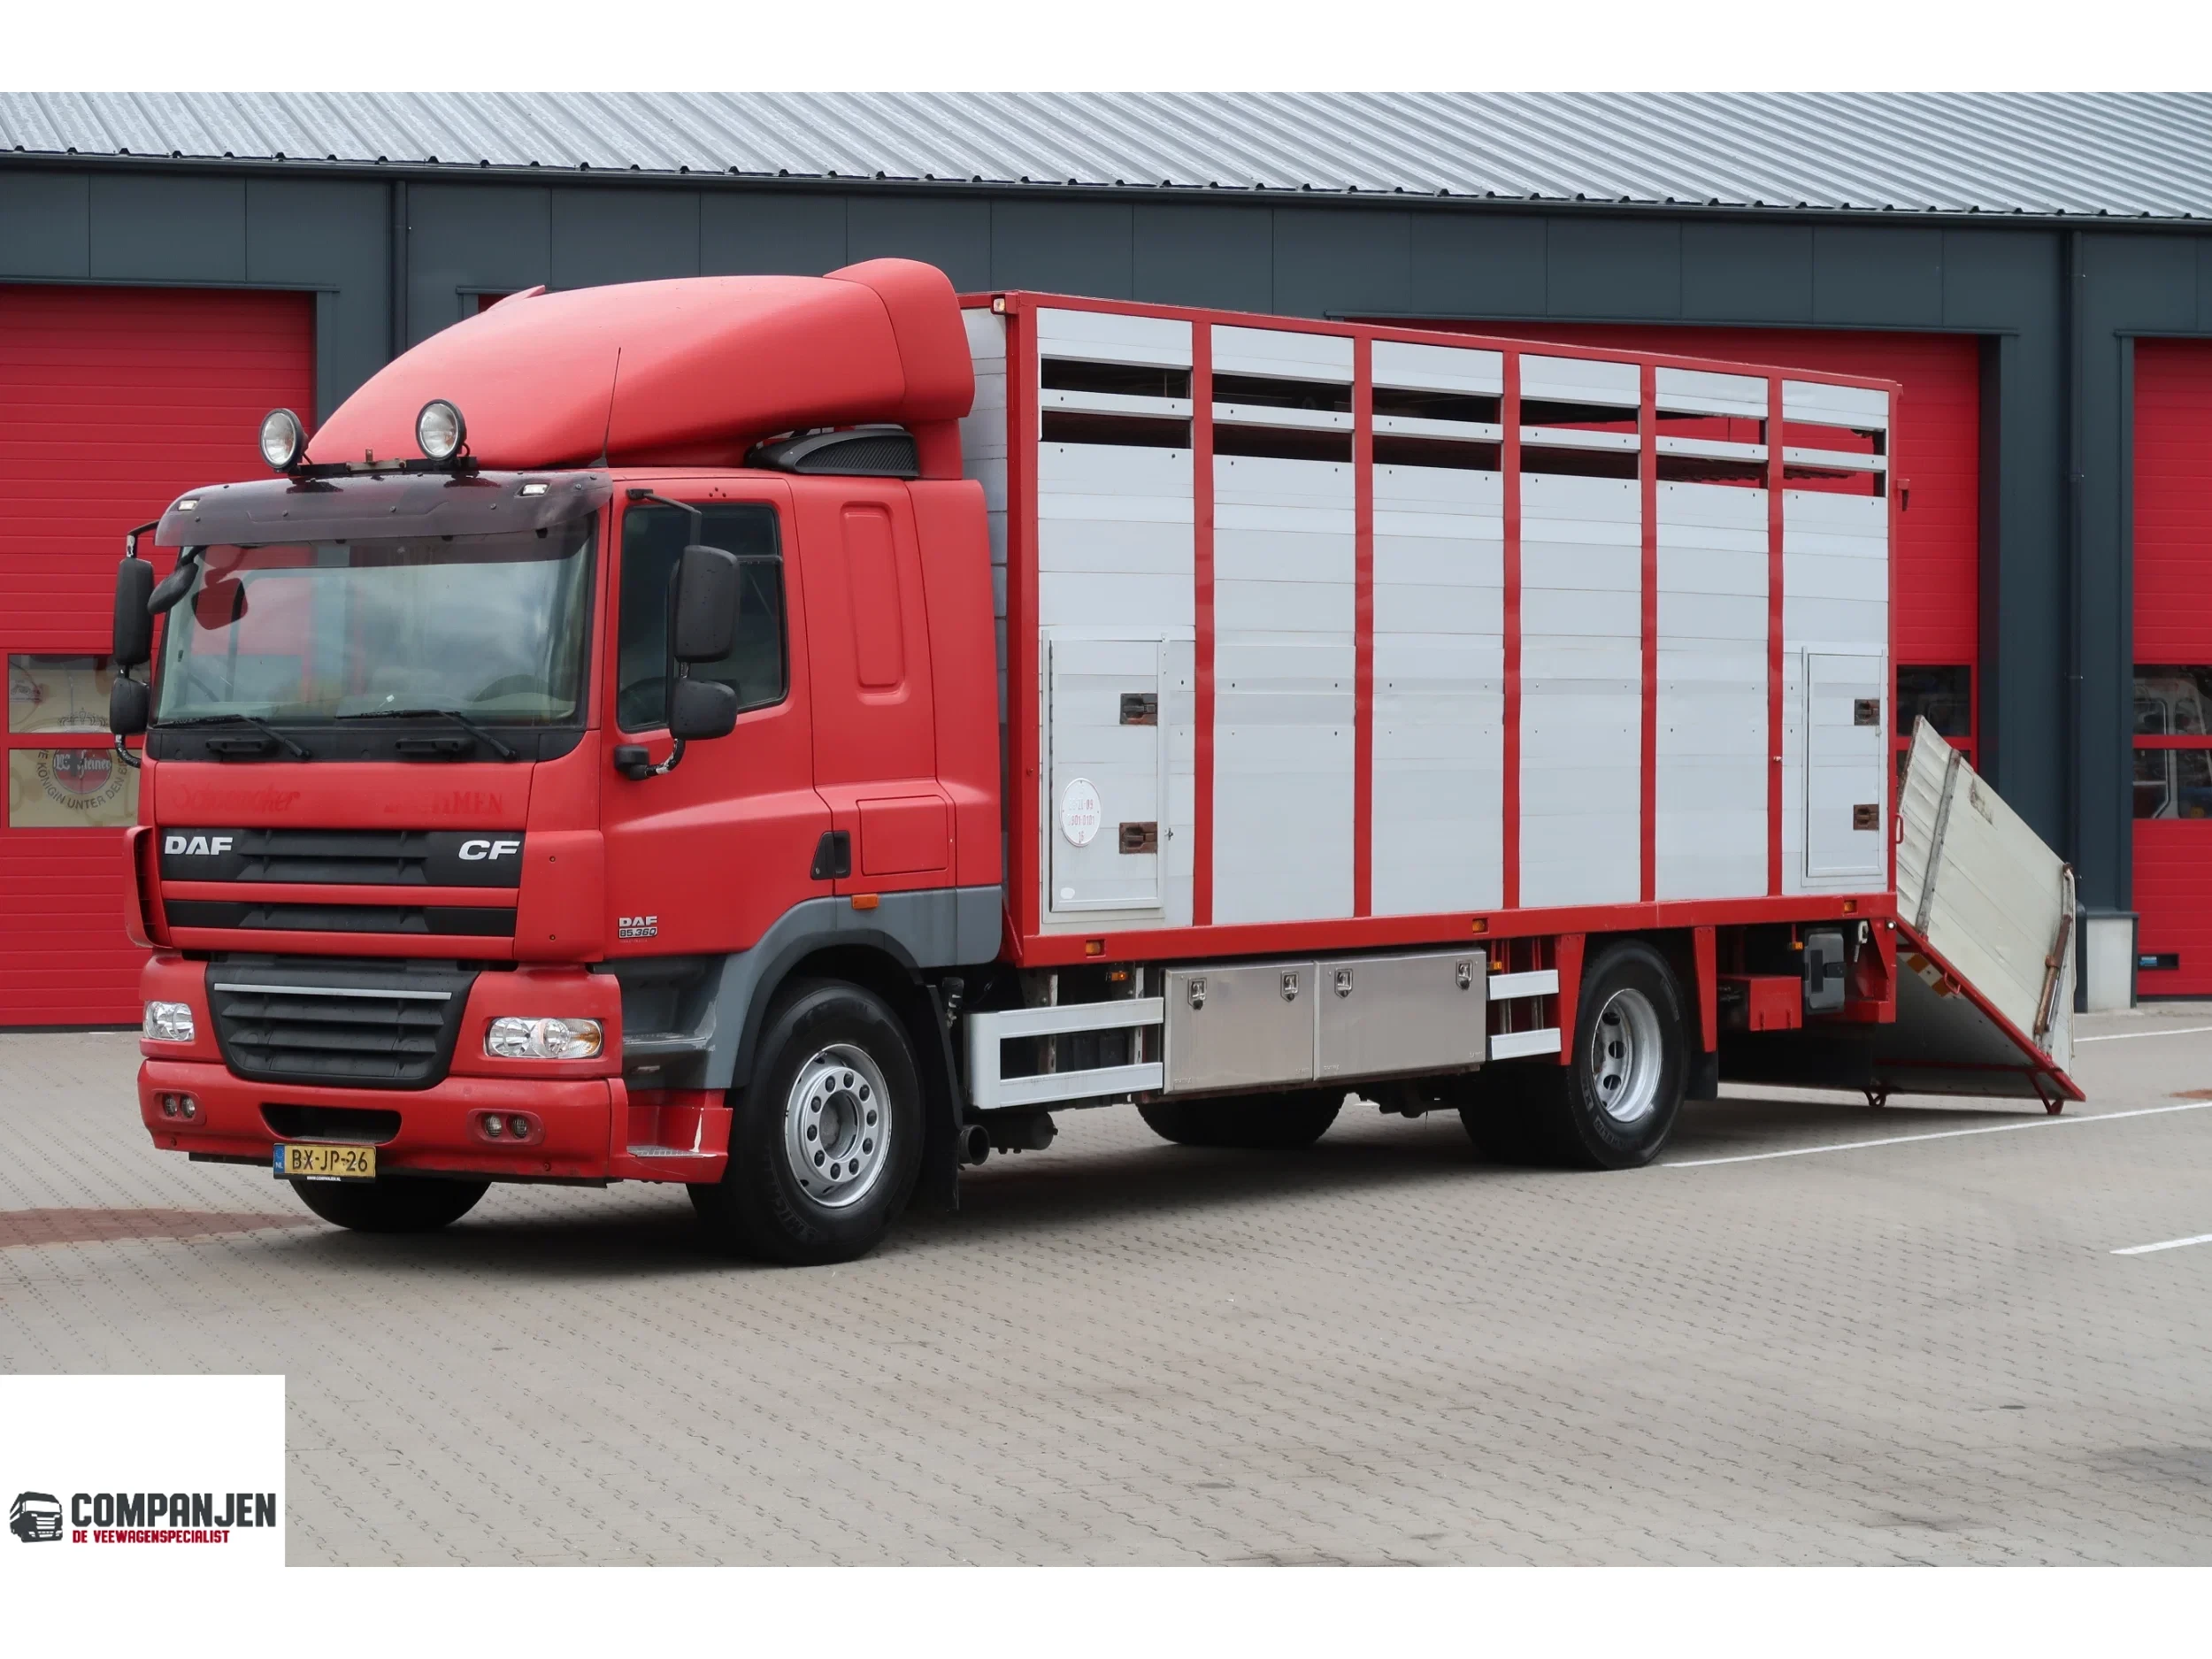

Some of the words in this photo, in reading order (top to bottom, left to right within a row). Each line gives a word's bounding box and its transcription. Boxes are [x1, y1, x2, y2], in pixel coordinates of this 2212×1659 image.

[37, 763, 65, 804] KÖNIGIN
[67, 795, 106, 810] UNTER
[107, 777, 125, 800] DEN
[164, 835, 234, 856] DAF
[457, 840, 520, 860] CF
[618, 915, 657, 927] DAF
[619, 927, 657, 938] 85.360
[292, 1148, 368, 1172] BX-JP-26
